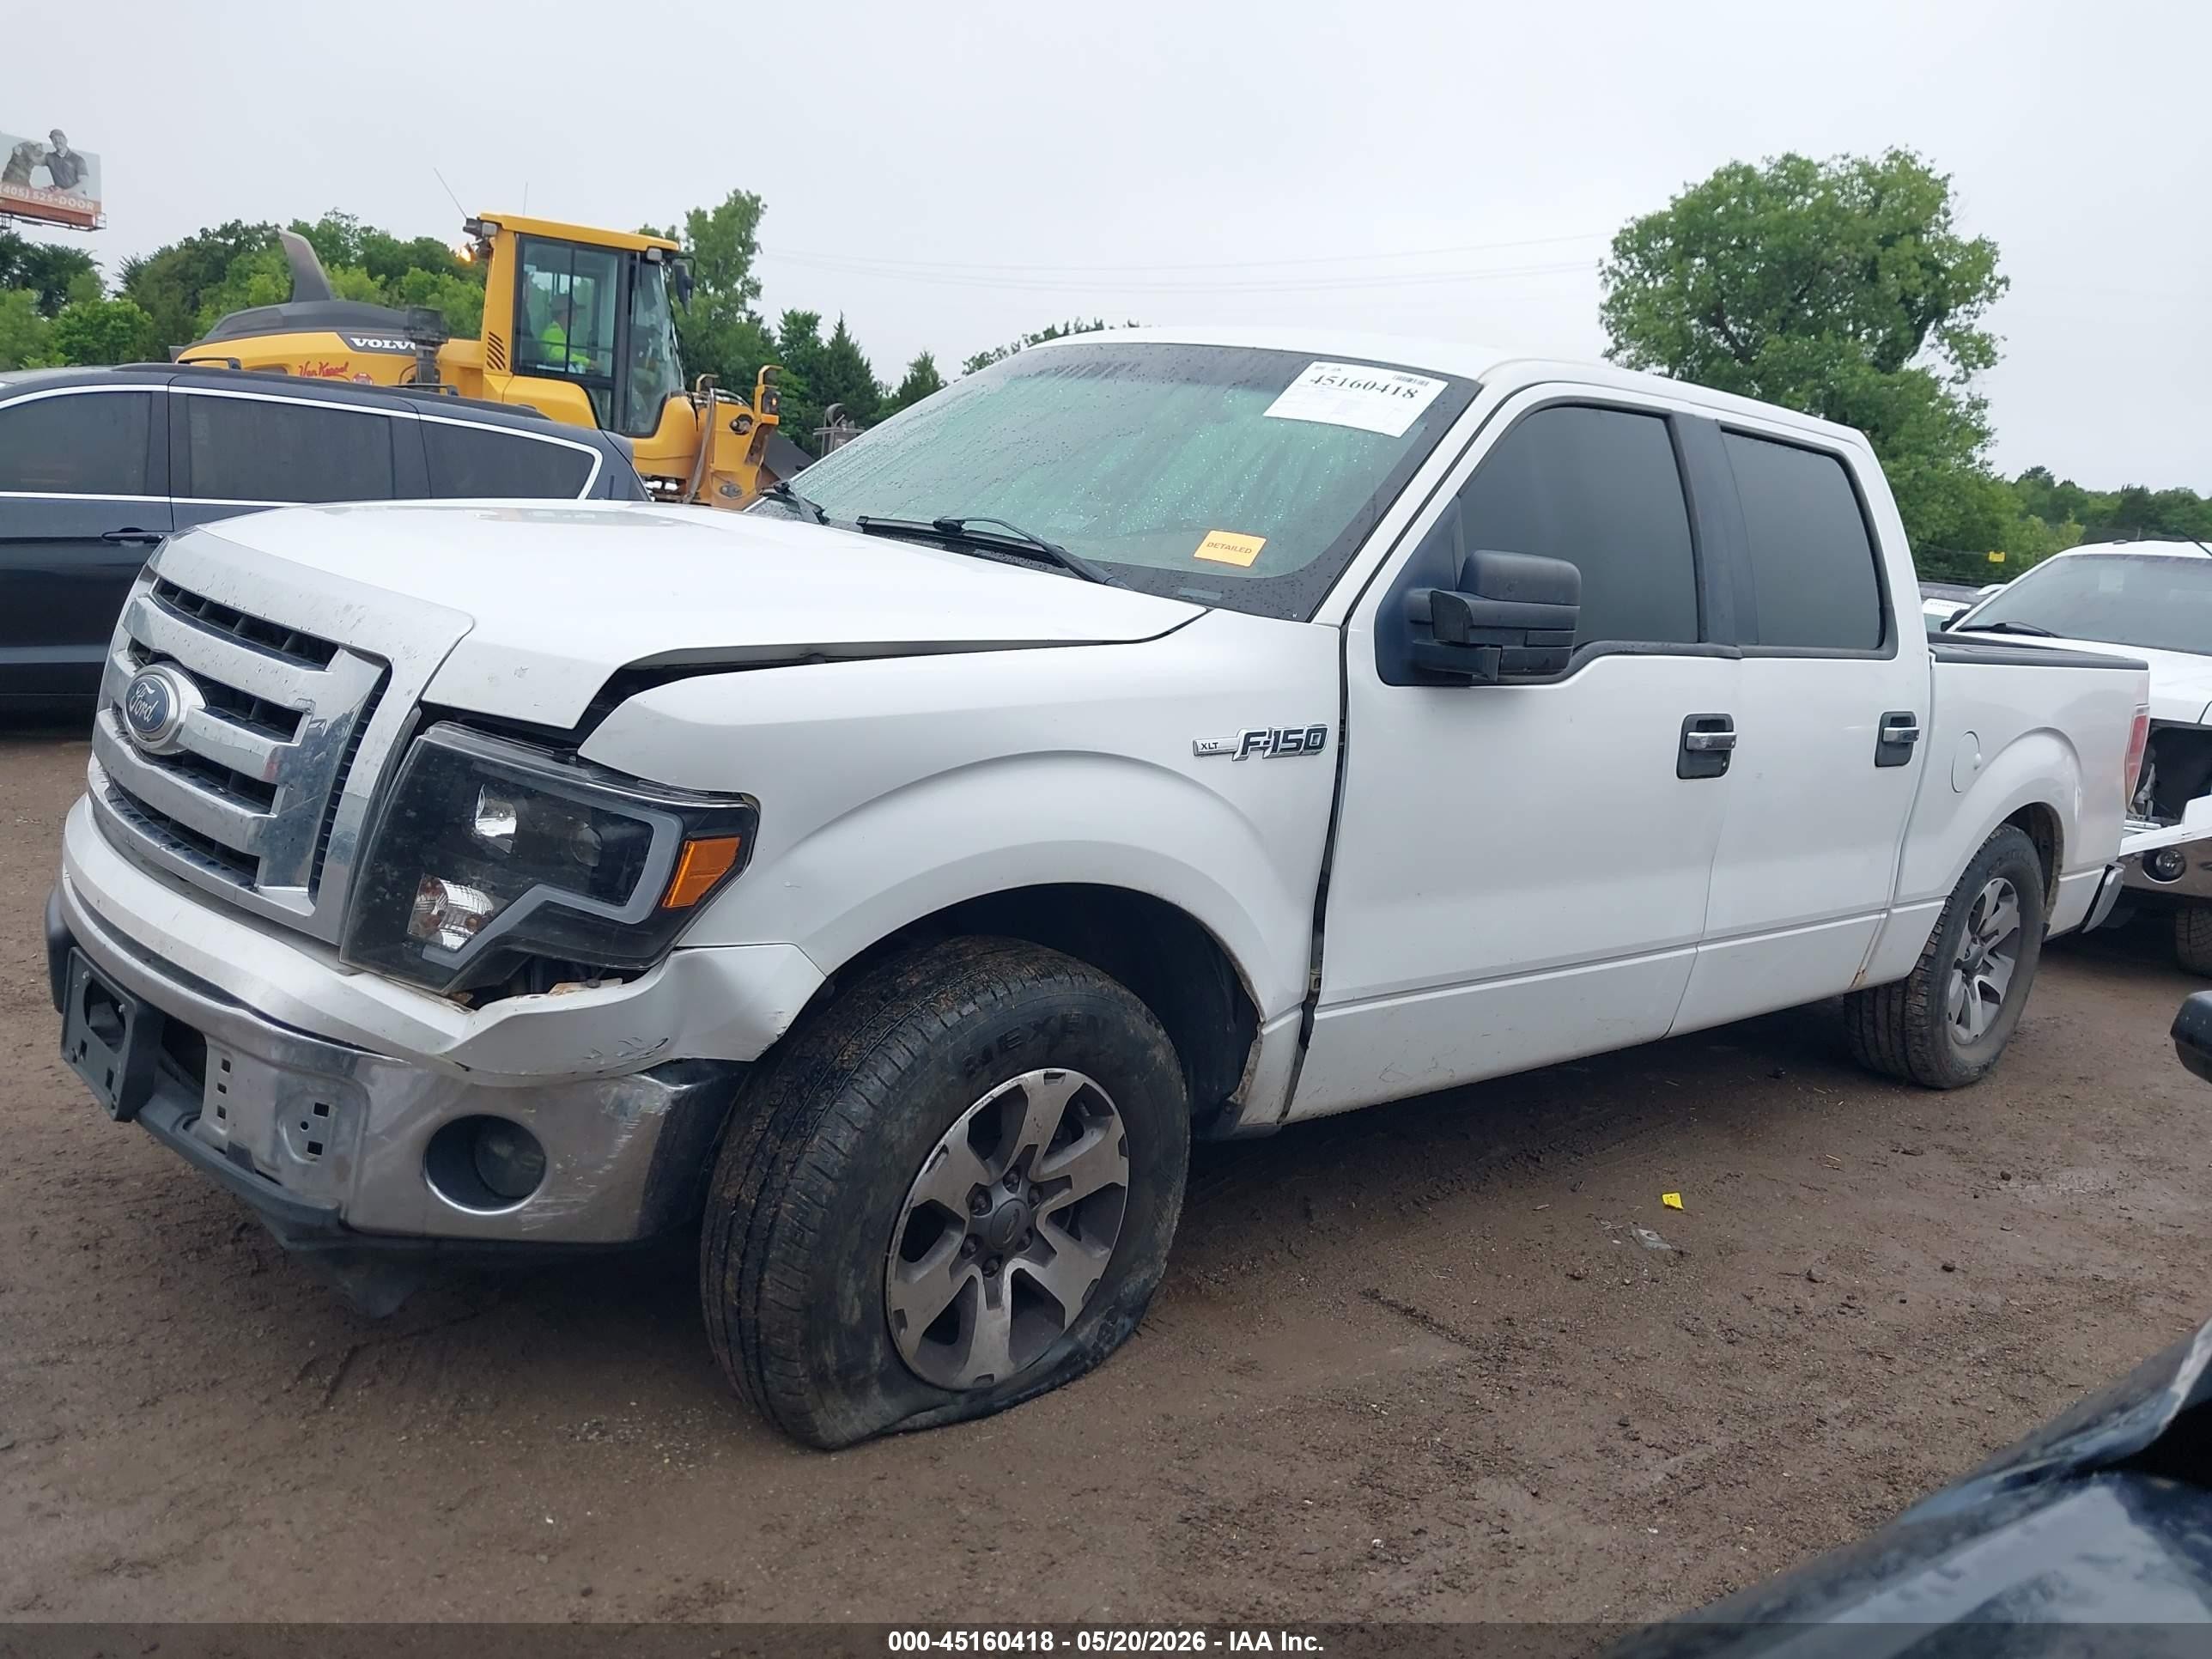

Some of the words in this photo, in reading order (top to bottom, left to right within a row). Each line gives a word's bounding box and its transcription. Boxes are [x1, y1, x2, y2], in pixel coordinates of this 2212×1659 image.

[33, 190, 95, 211] 525-DOOR
[1309, 374, 1419, 399] 45160418
[1206, 542, 1253, 555] DETAILED
[129, 682, 159, 723] Ford
[1200, 741, 1219, 751] XLT
